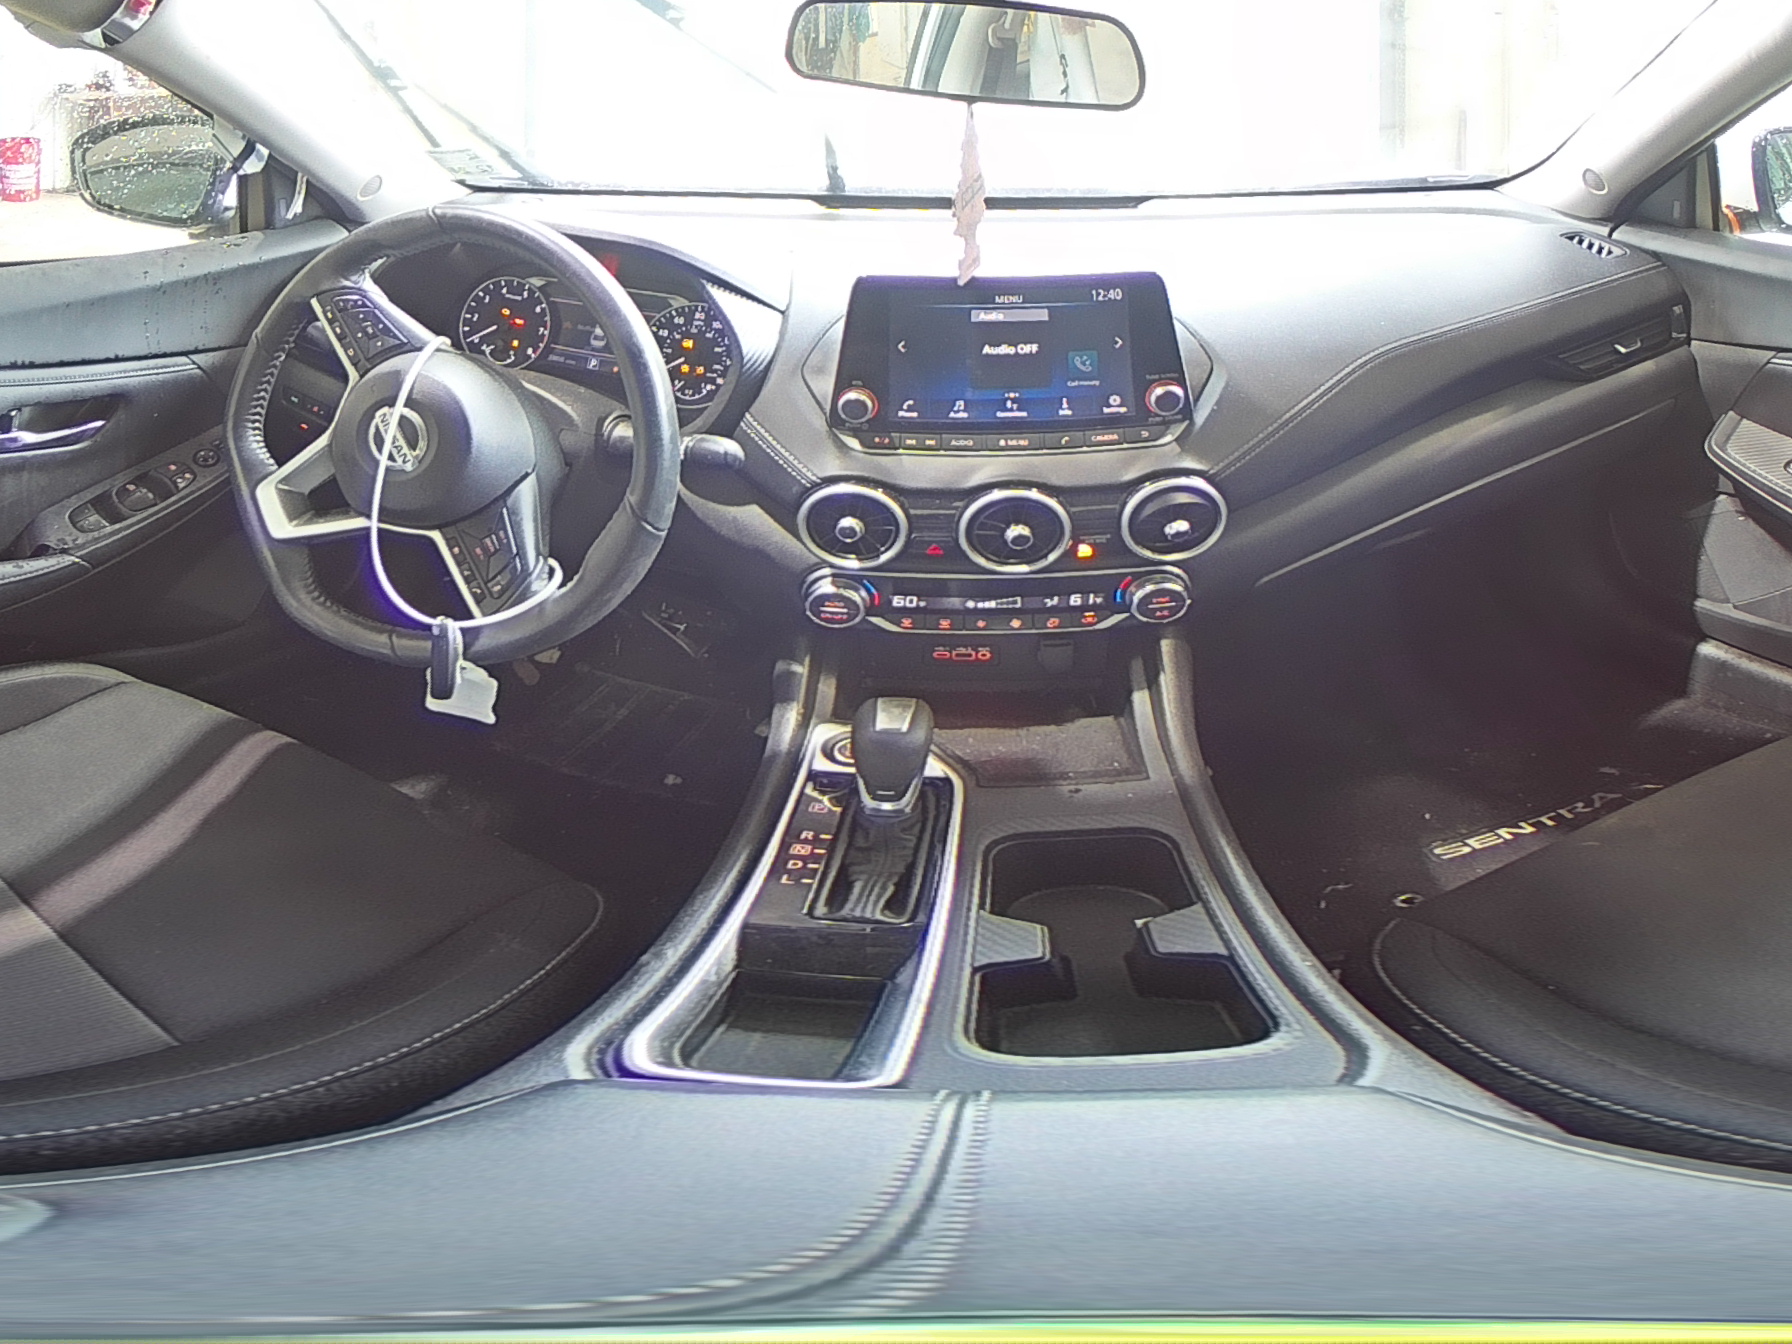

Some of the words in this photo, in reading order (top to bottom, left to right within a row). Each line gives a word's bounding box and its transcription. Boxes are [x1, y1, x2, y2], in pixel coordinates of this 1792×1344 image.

[995, 295, 1023, 304] MENU
[1091, 288, 1123, 302] 12:40
[978, 311, 1005, 320] Audio
[982, 344, 1016, 355] Audio
[1017, 344, 1039, 355] OFF
[378, 412, 412, 466] NISAN
[1091, 433, 1119, 442] CAMERA
[1432, 790, 1622, 860] SENTRA
[799, 830, 815, 840] R
[786, 859, 804, 869] D
[780, 873, 795, 884] L
